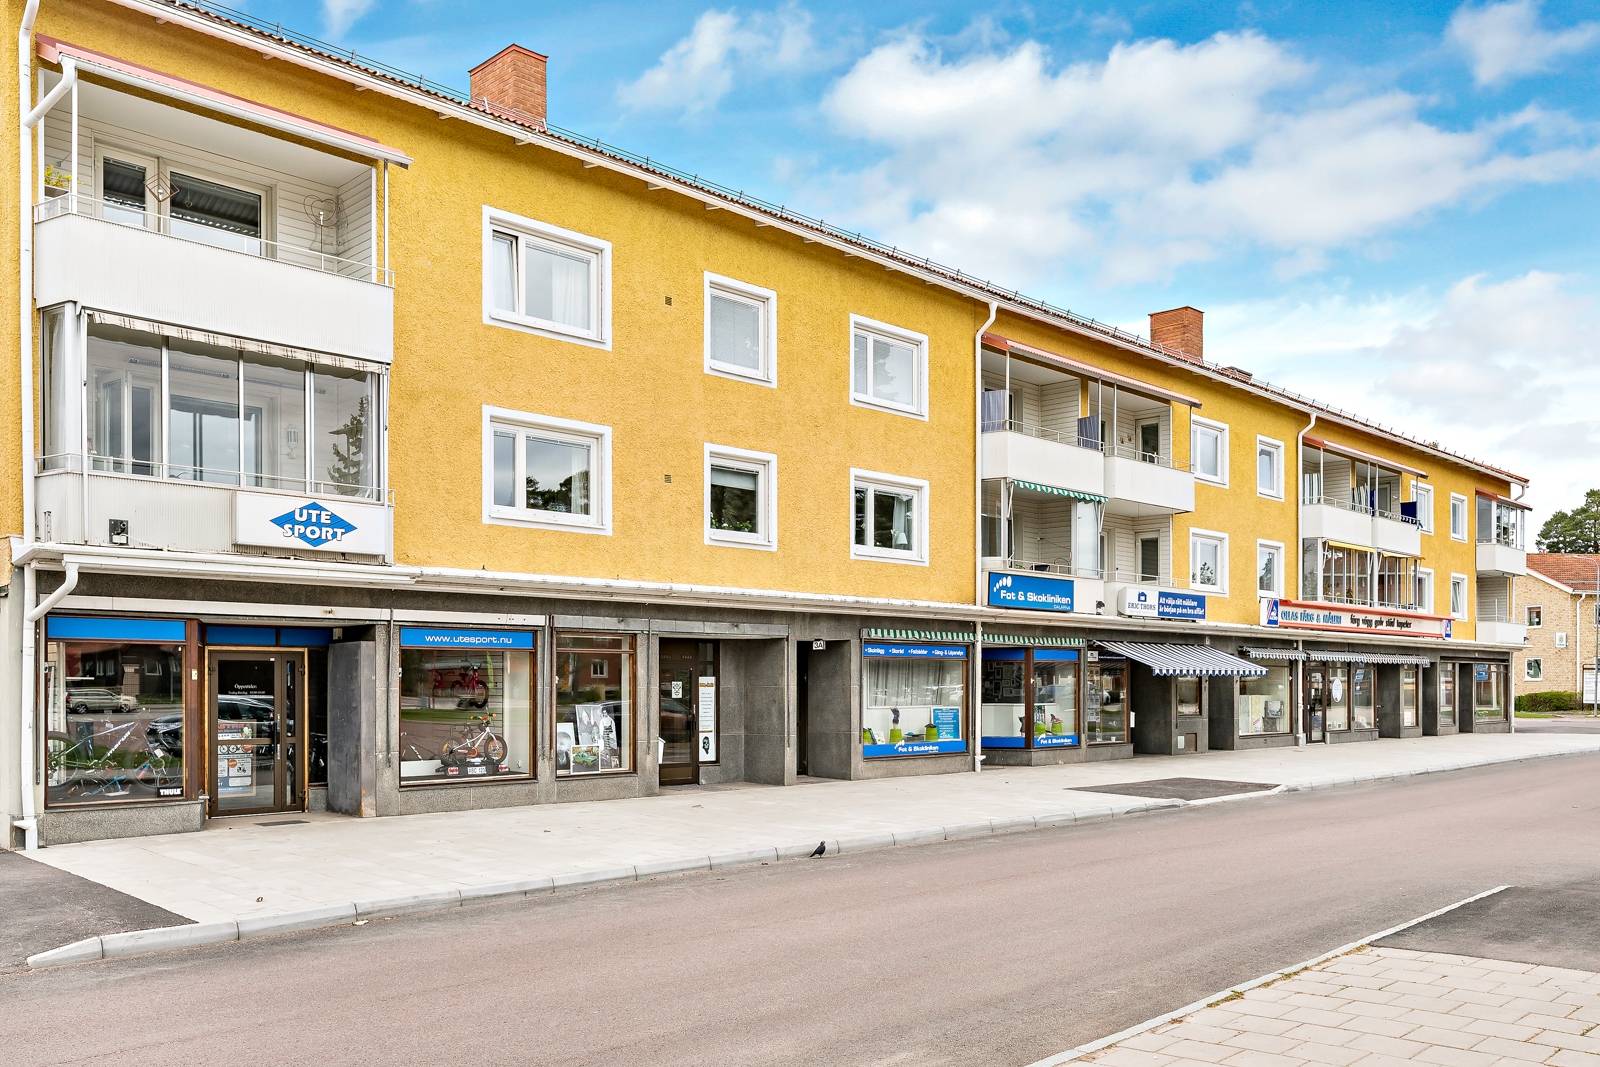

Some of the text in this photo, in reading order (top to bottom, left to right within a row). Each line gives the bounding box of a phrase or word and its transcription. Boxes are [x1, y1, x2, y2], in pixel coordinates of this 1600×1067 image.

[294, 508, 332, 524] UTE
[283, 523, 345, 541] SPORT
[1000, 589, 1071, 604] Fot & Skokliniken
[424, 635, 512, 645] www.utesport.nu
[159, 788, 182, 796] THULE
